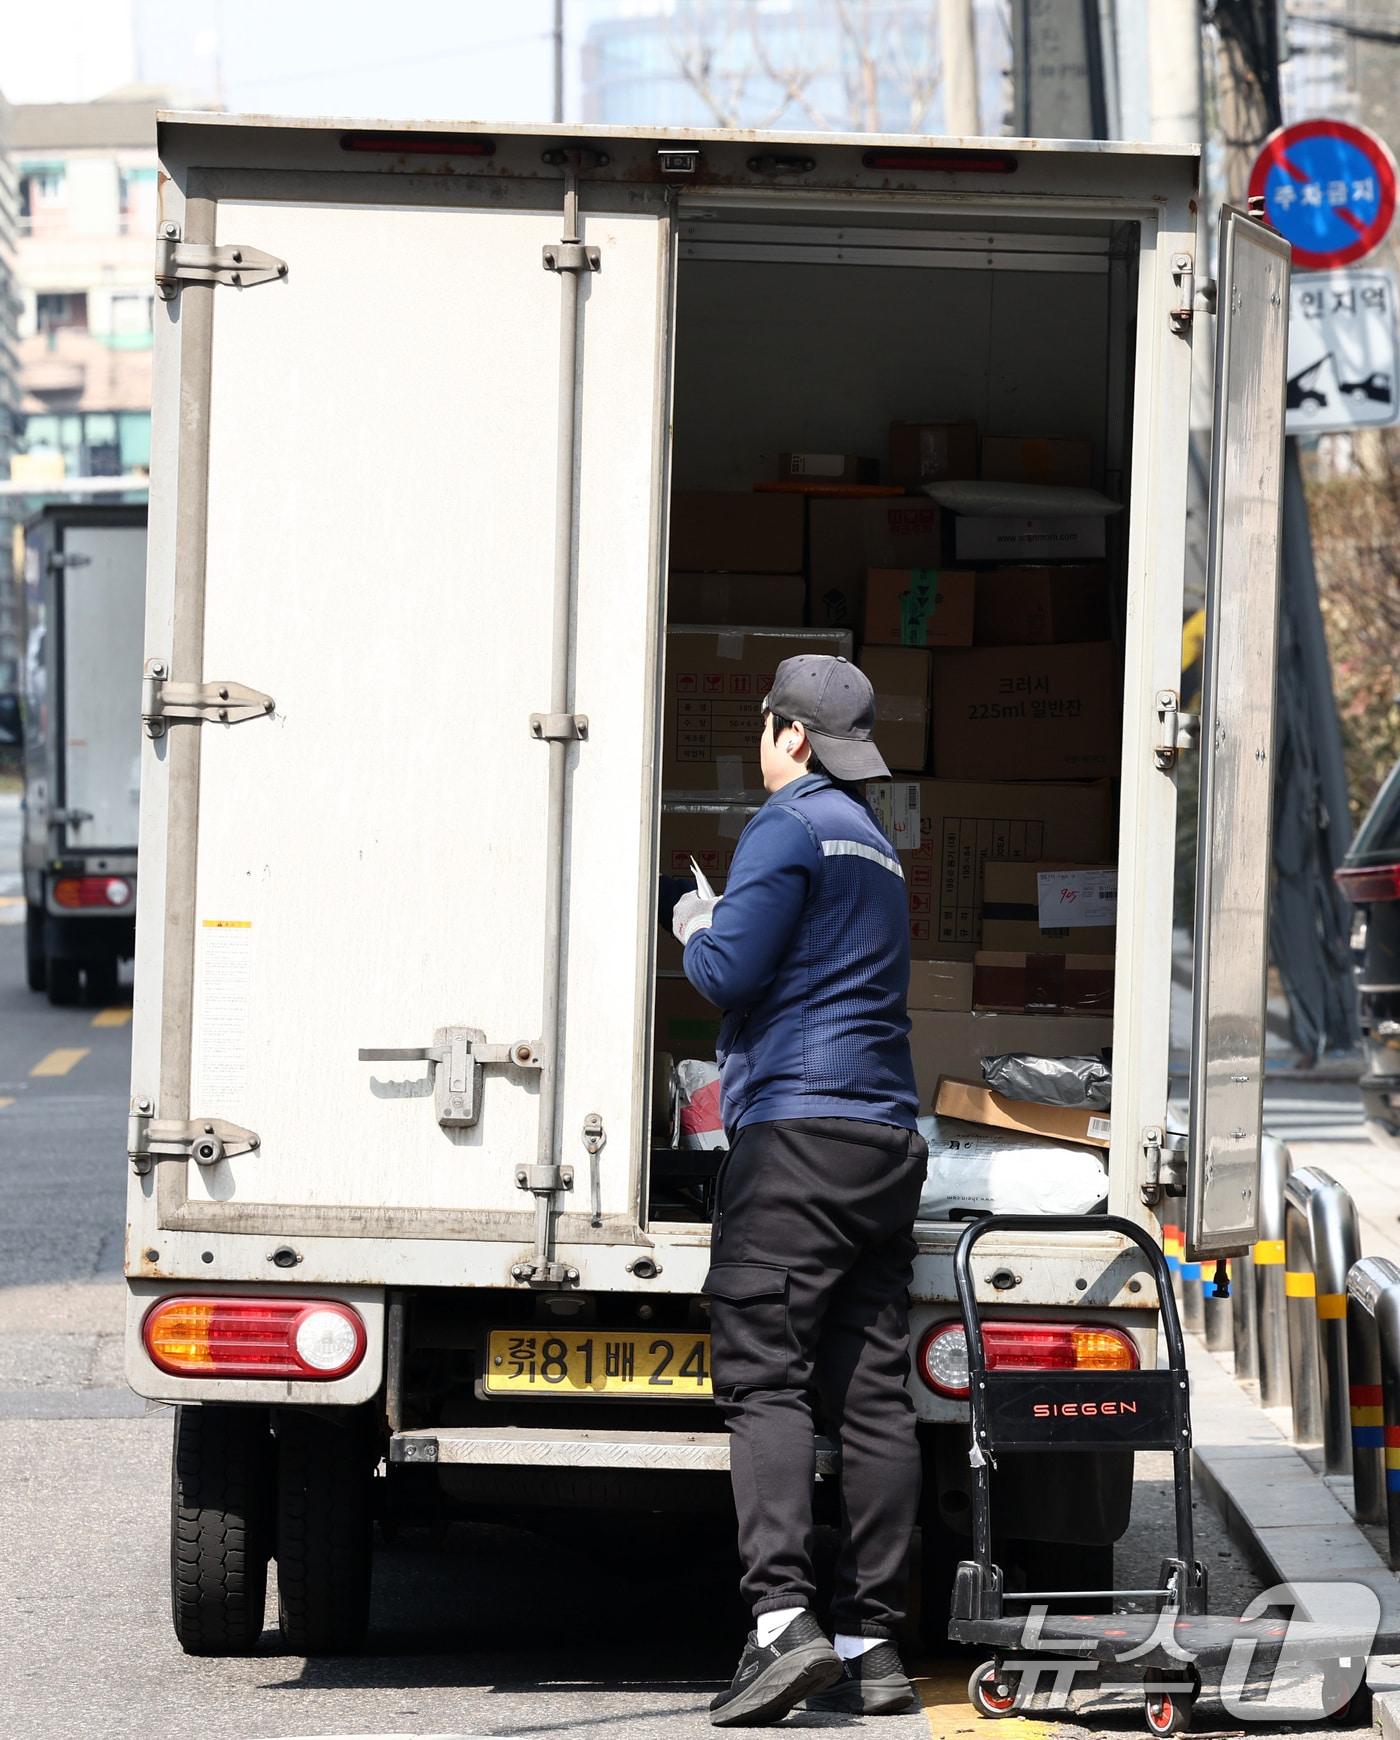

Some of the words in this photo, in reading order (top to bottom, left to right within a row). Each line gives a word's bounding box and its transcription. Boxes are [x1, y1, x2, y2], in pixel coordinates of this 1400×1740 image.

[1276, 177, 1375, 210] 주차금지
[1297, 288, 1387, 319] 인지역
[999, 675, 1049, 694] 크러시
[968, 702, 1025, 720] 225ml
[1031, 698, 1083, 719] 일반잔
[1058, 888, 1080, 904] 905
[508, 1338, 536, 1384] 경기
[540, 1338, 635, 1384] 81배
[1033, 1401, 1137, 1417] SIEGEN
